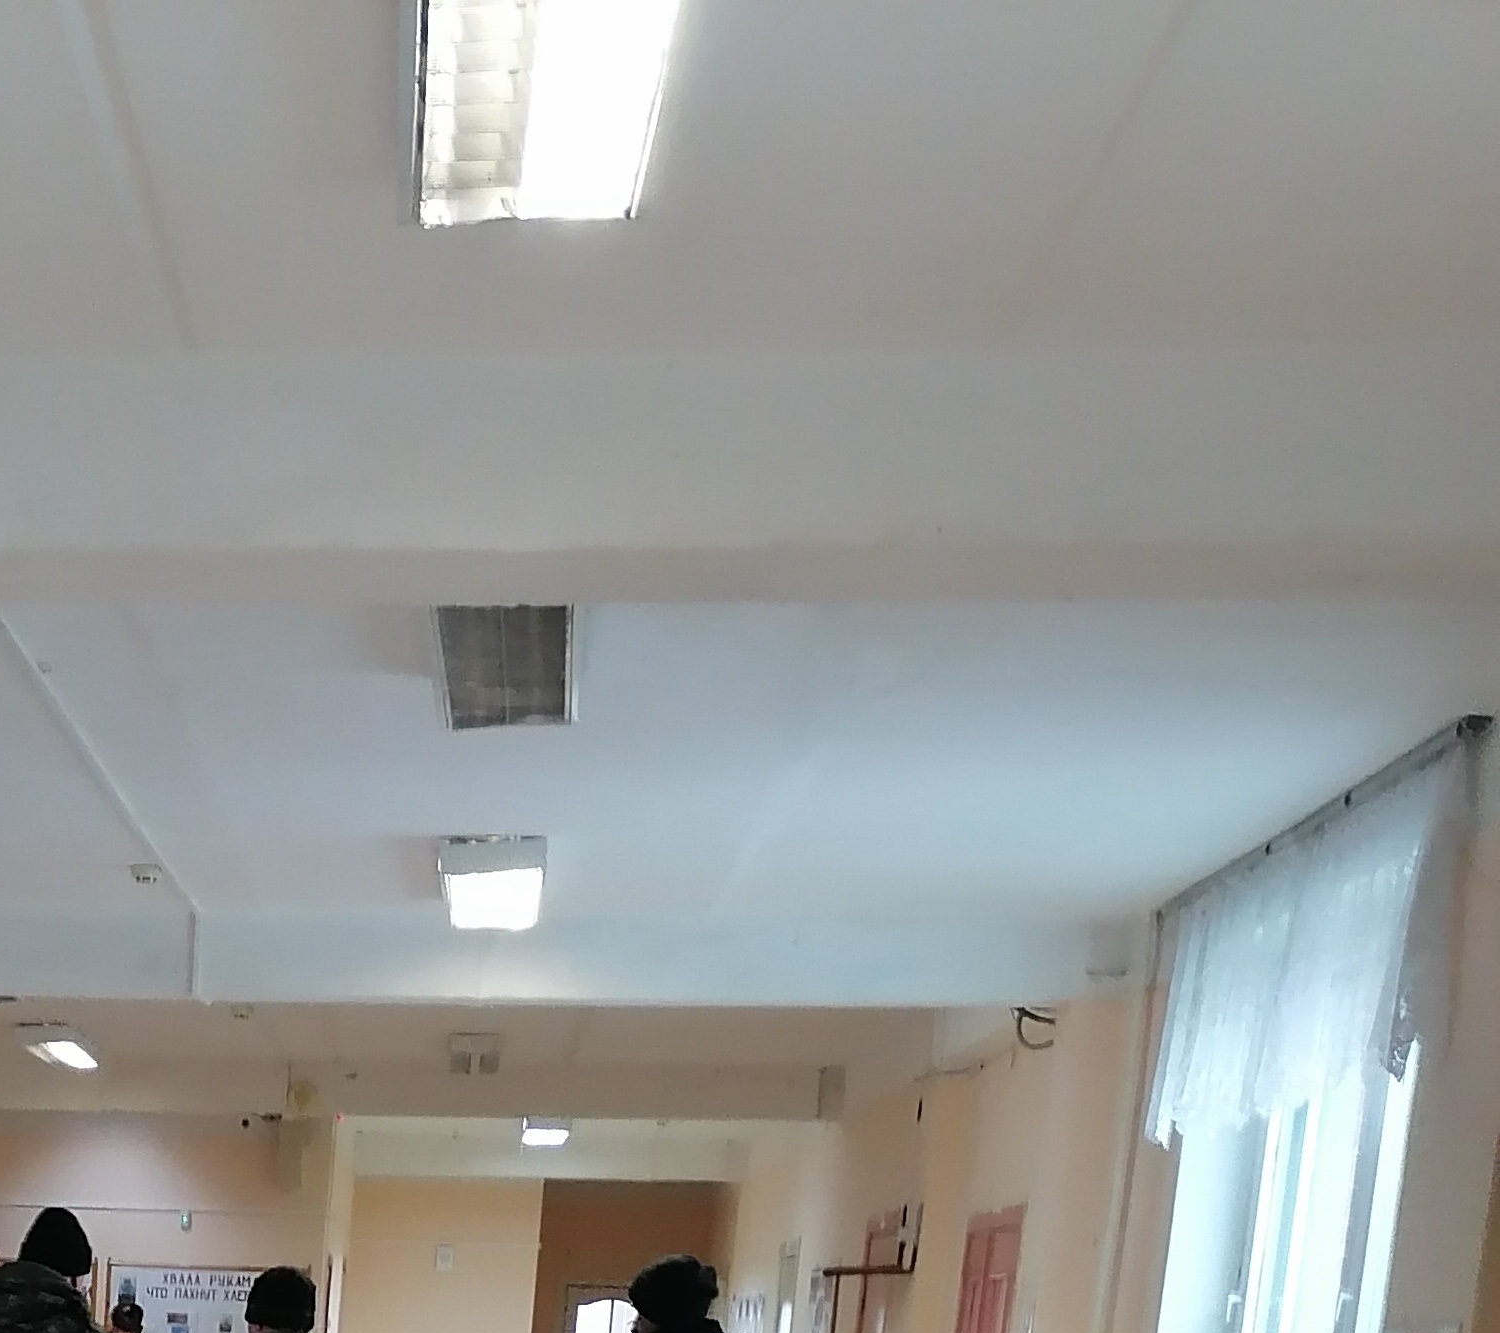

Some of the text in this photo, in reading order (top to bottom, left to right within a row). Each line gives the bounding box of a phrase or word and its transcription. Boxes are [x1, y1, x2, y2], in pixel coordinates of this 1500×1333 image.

[162, 1272, 200, 1287] ХВАЛА
[146, 1286, 168, 1299] ЧТО
[173, 1288, 217, 1302] ПАХНУТ
